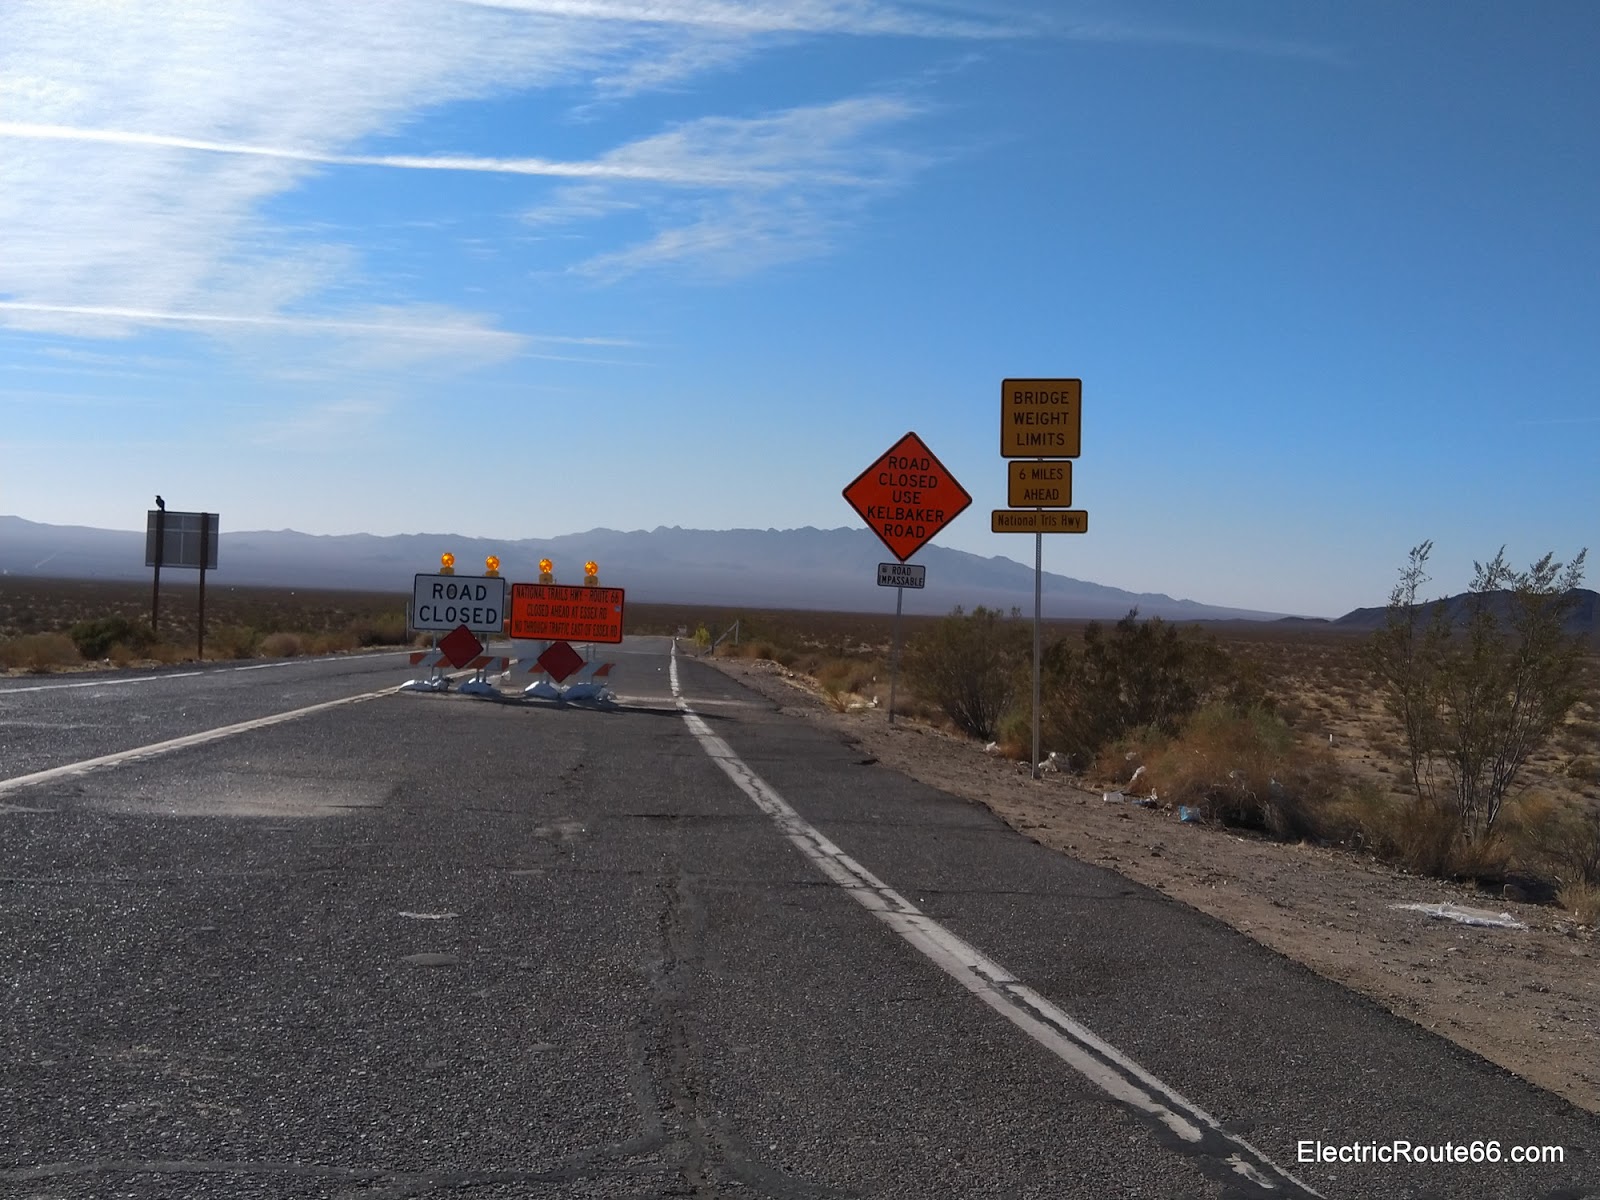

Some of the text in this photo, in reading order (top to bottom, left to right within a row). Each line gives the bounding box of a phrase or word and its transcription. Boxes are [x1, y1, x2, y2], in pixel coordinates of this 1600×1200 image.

[1014, 391, 1069, 405] BRIDGE
[1014, 412, 1069, 425] WEIGHT
[1017, 432, 1065, 446] LIMITS
[888, 456, 930, 471] ROAD
[879, 473, 938, 489] CLOSED
[1019, 468, 1063, 480] 6 MILES
[892, 490, 921, 505] USE
[1024, 488, 1060, 501] AHEAD
[867, 506, 944, 523] KELBAKER
[998, 514, 1036, 527] National
[1061, 514, 1081, 529] Hwy
[884, 524, 926, 539] ROAD
[892, 566, 912, 576] ROAD
[879, 575, 923, 586] IMPASSABLE
[432, 583, 487, 601] ROAD
[516, 586, 545, 599] NATIONAL
[548, 588, 568, 601] TRAILS
[570, 589, 583, 602] HWY
[590, 590, 608, 603] ROUTE
[611, 591, 619, 604] 66
[419, 605, 498, 625] CLOSED
[527, 604, 607, 620] CLOSED AHEAD AT ESSEX RD
[515, 620, 522, 633] NO
[524, 620, 547, 634] THROUGH
[549, 622, 569, 635] TRAFFIC
[571, 623, 584, 636] EAST
[593, 624, 608, 637] ESSEX
